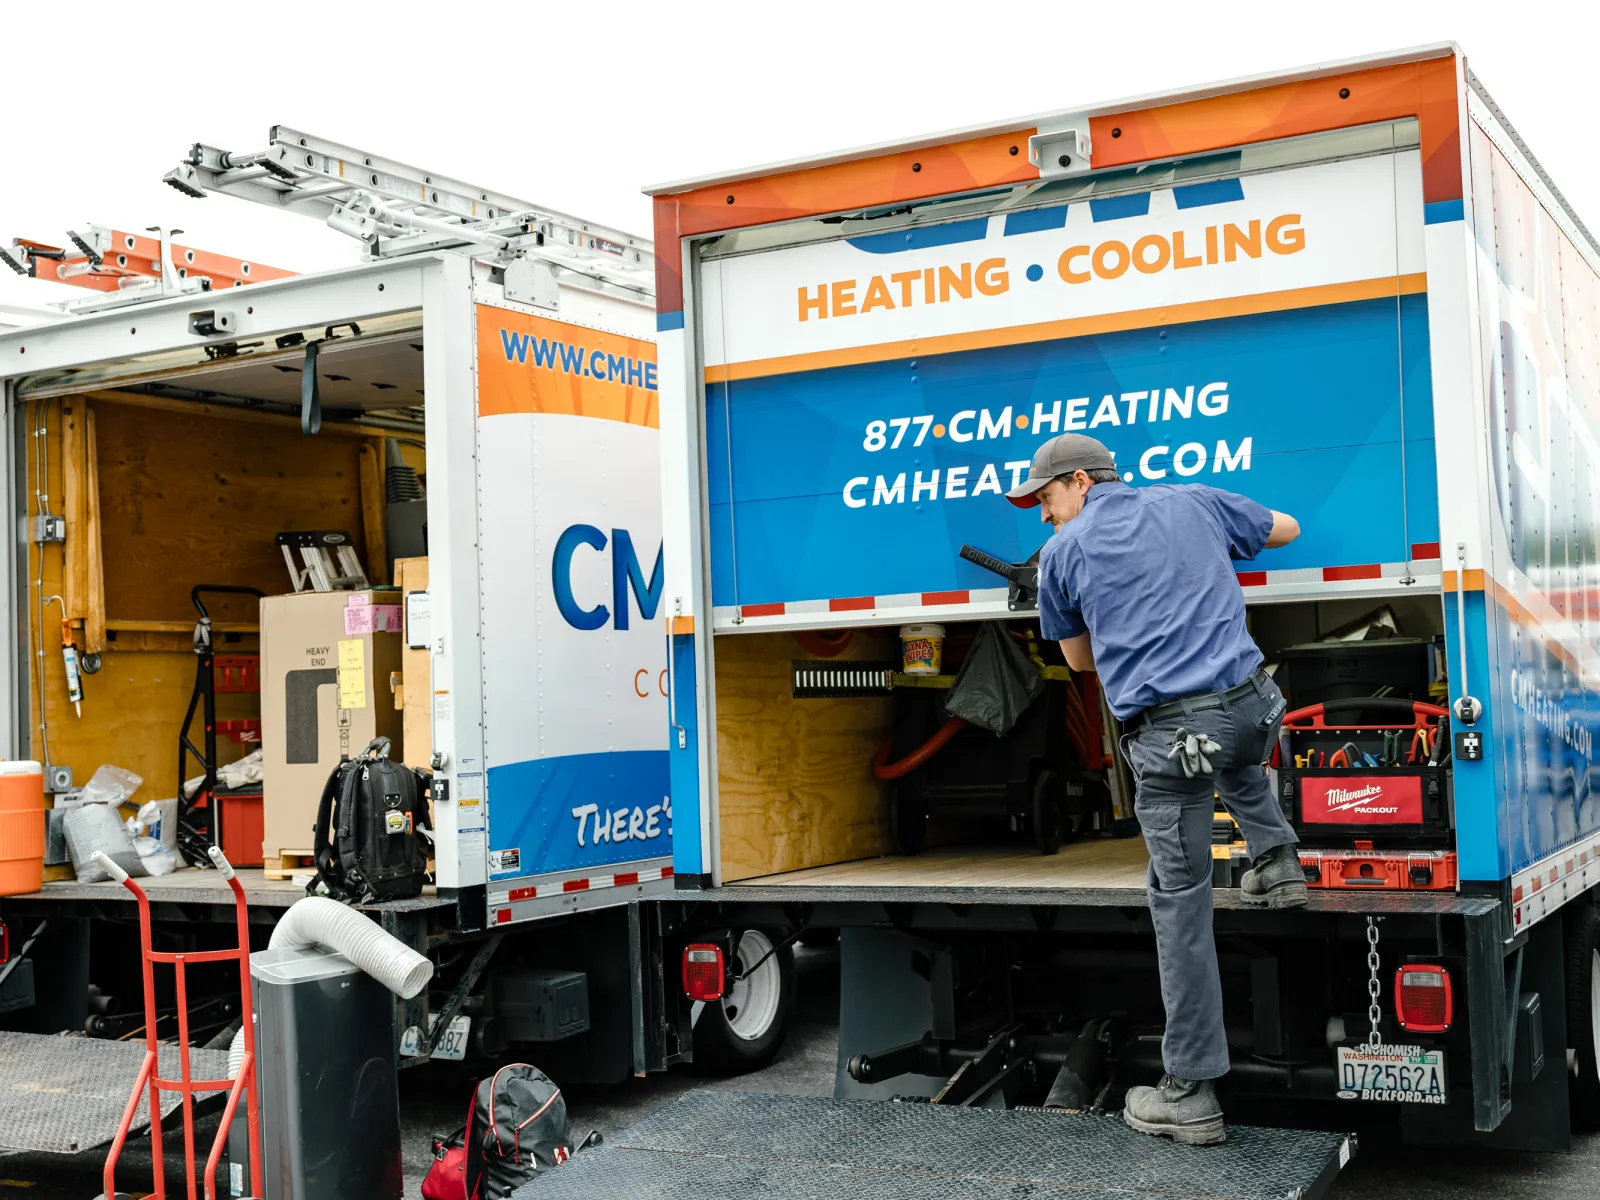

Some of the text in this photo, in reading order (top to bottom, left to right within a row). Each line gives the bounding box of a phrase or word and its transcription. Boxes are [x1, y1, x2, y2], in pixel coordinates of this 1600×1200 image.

[797, 257, 1011, 322] HEATING
[1057, 213, 1306, 284] COOLING
[842, 436, 1253, 509] CMHEAT.COM
[305, 646, 330, 656] HEAVY
[904, 648, 933, 661] WIPES
[311, 658, 326, 667] END
[1511, 669, 1593, 761] CMHEATING.COM
[1324, 784, 1383, 806] Milwaukee
[1343, 1052, 1403, 1062] WASHINGTON
[1343, 1063, 1440, 1094] D72562A
[1361, 1089, 1446, 1104] BICKFORD.net
